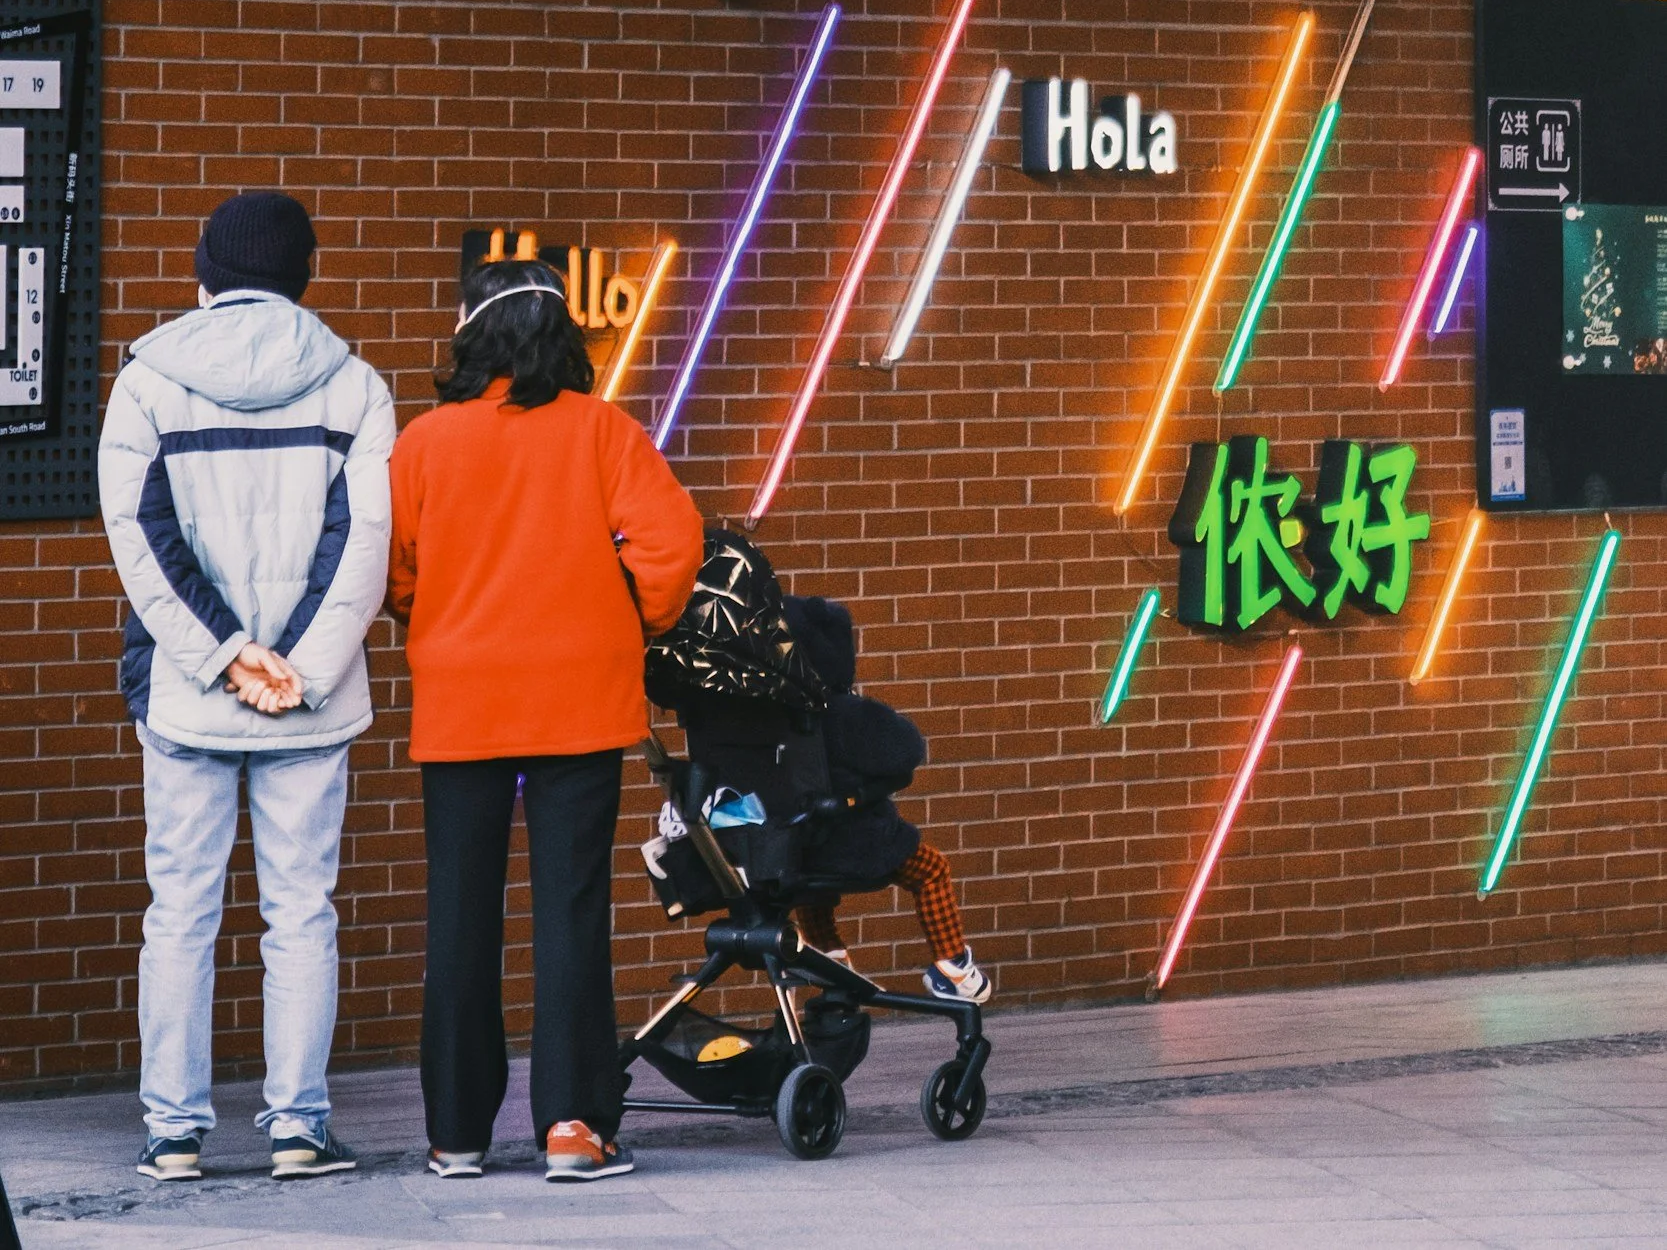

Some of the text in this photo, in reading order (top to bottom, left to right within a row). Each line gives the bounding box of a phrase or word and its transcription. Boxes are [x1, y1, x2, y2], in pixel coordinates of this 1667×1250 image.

[23, 23, 41, 35] Road
[3, 77, 14, 92] 17
[32, 77, 44, 93] 19
[1048, 75, 1178, 175] Hola
[1499, 110, 1529, 136] 公共
[62, 232, 71, 262] Matou
[59, 264, 68, 293] Street
[489, 226, 640, 329] llo
[26, 289, 38, 304] 12
[9, 370, 38, 382] TOILET
[8, 423, 28, 435] South
[28, 420, 46, 431] Road
